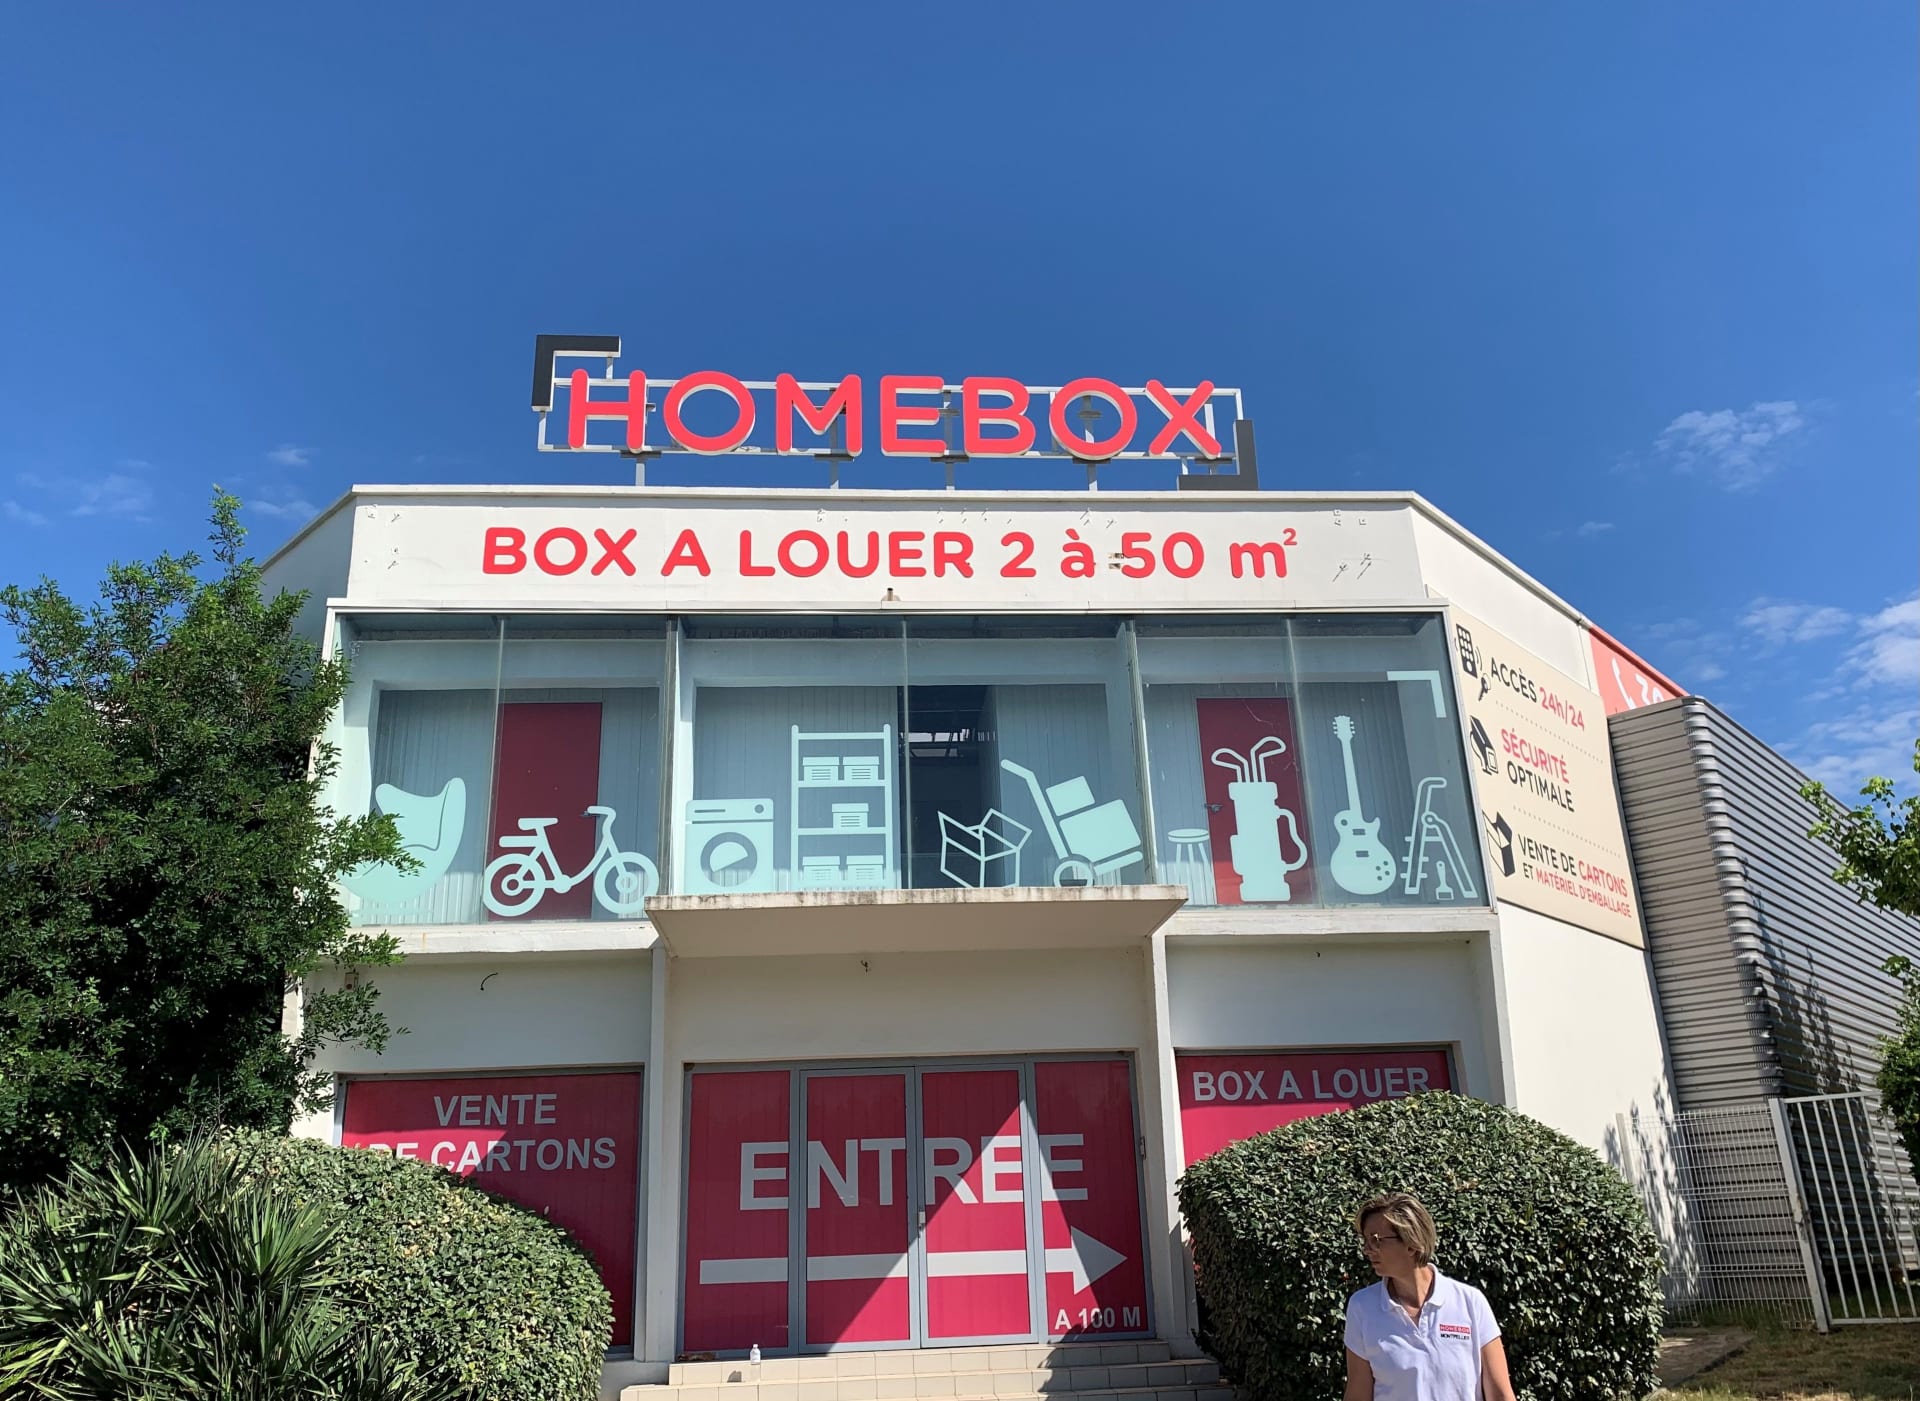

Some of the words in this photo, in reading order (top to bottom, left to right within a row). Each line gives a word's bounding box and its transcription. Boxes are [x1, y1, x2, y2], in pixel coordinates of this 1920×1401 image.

[568, 368, 1221, 462] HOMEBOX
[482, 527, 637, 576] BOX
[661, 528, 711, 577] A
[739, 529, 974, 578] LOUER
[1000, 531, 1037, 578] 2
[1060, 528, 1096, 578] à
[1121, 532, 1204, 578] 50
[1491, 656, 1537, 703] ACCÈS
[1539, 686, 1585, 731] 24h/24
[1501, 728, 1570, 784] SÉCURITÉ
[1507, 760, 1575, 812] OPTIMALE
[1517, 834, 1559, 870] VENTE
[1560, 852, 1577, 877] DE
[1578, 860, 1628, 898] CARTONS
[1522, 862, 1534, 880] ET
[1535, 867, 1579, 898] MATÉRIEL
[1579, 884, 1632, 918] D'EMBALLAGE
[433, 1093, 557, 1127] VENTE
[1192, 1070, 1268, 1101] BOX
[1278, 1069, 1303, 1100] A
[1312, 1067, 1429, 1099] LOUER
[430, 1137, 617, 1173] CARTONS
[739, 1133, 1089, 1211] ENTREE
[1054, 1308, 1073, 1330] A
[1078, 1307, 1116, 1329] 100
[1122, 1306, 1141, 1328] M
